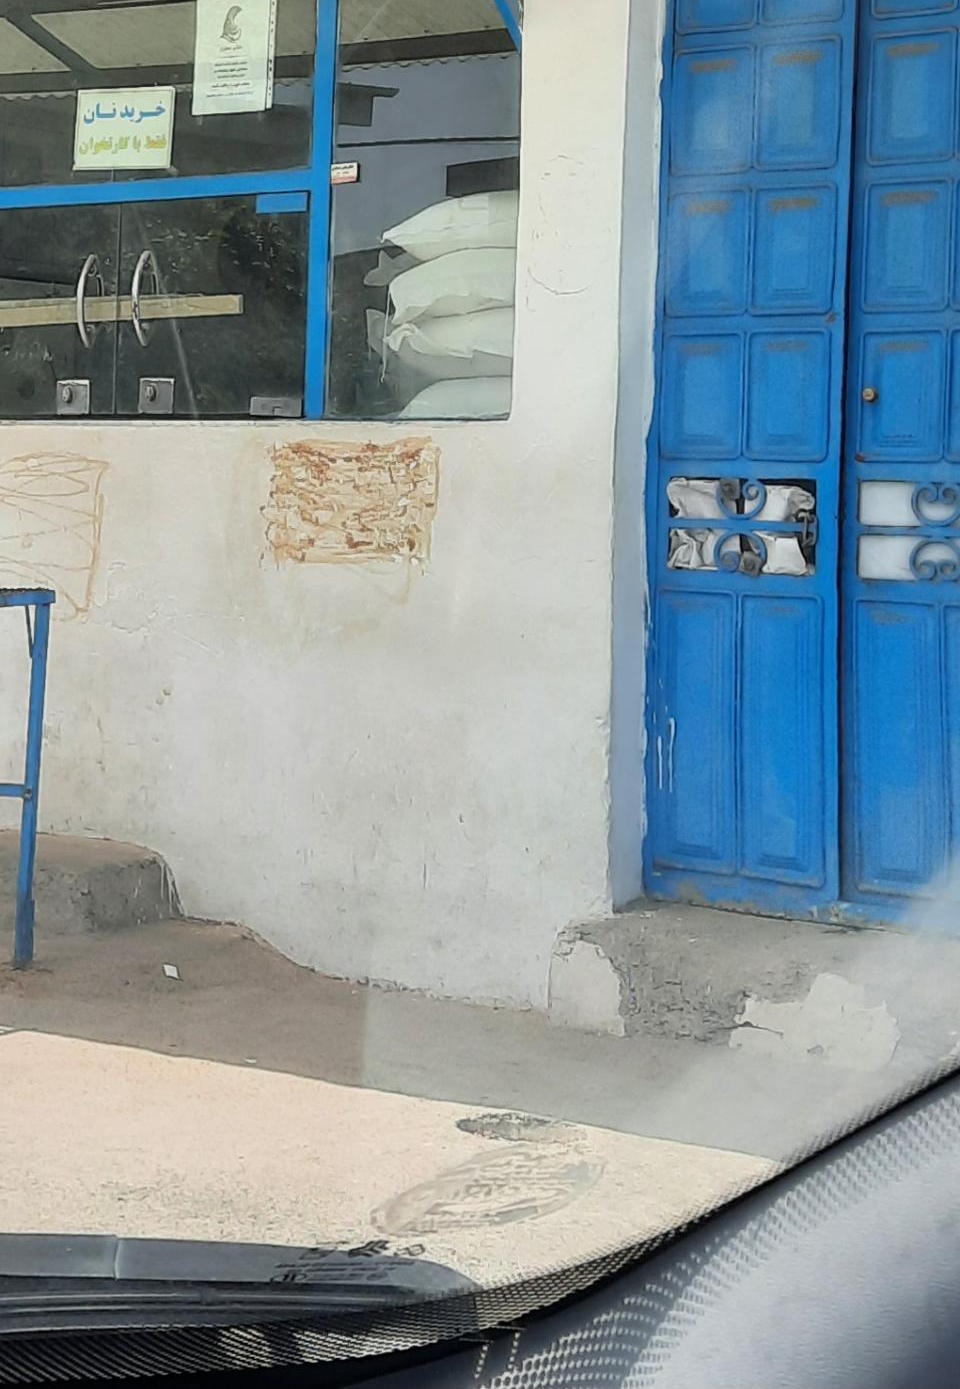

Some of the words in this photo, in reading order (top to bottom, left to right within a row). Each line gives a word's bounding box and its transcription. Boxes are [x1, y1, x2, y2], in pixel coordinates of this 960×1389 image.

[83, 101, 117, 125] نان
[120, 100, 166, 124] خرید
[132, 134, 142, 154] با
[143, 133, 168, 150] فقط
